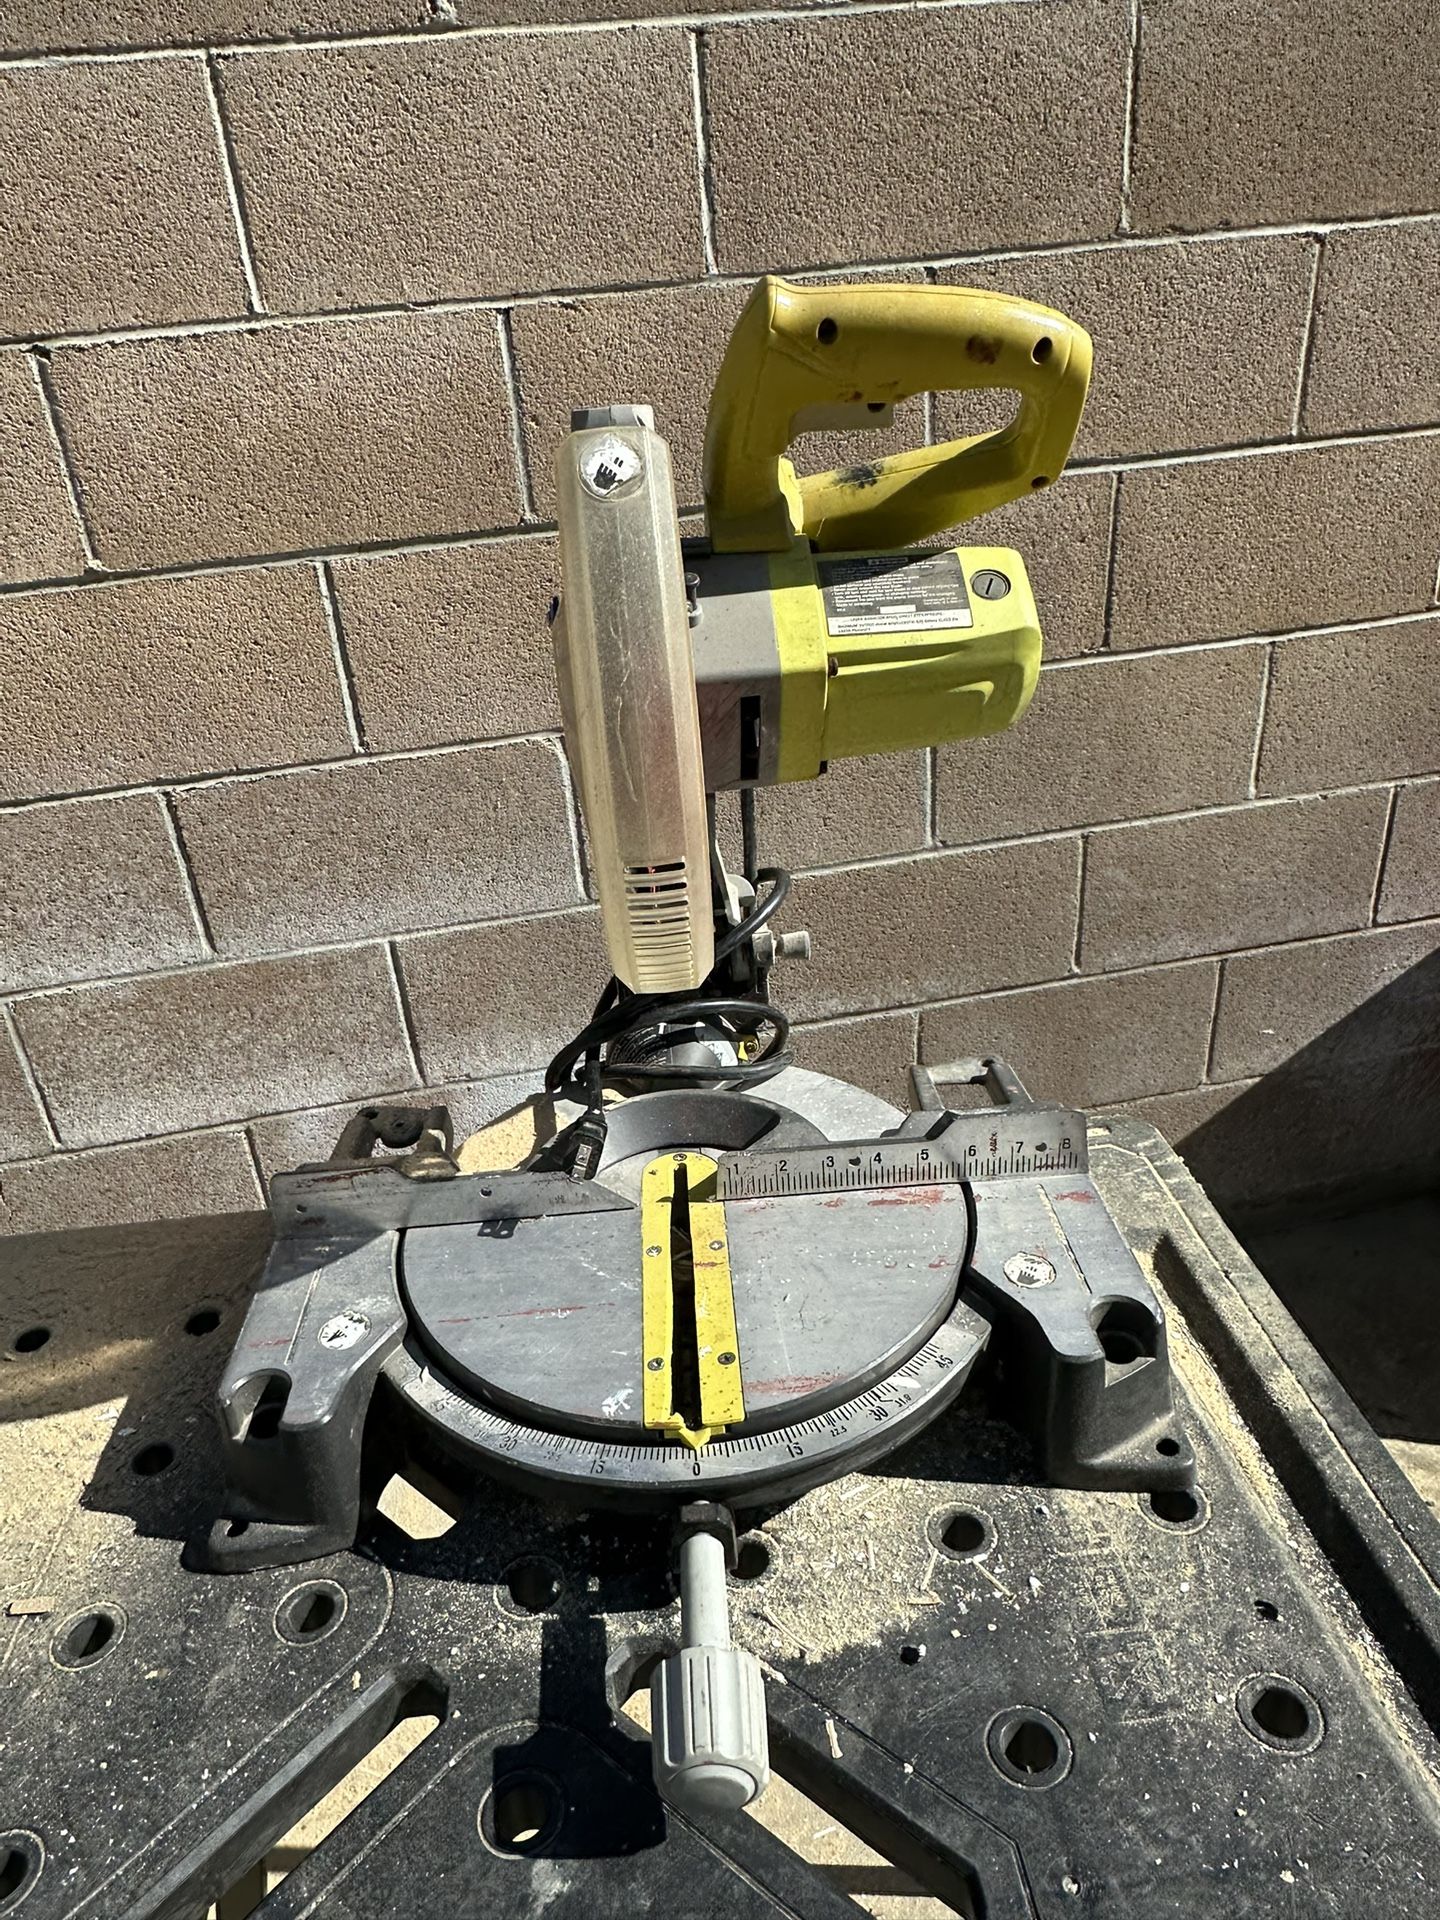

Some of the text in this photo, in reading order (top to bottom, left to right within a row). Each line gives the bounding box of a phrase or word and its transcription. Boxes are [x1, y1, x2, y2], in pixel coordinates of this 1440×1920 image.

[733, 1138, 1071, 1175] 1 2 3 4 5 6 7 8
[499, 1435, 518, 1451] 30
[590, 1459, 605, 1474] 15
[692, 1462, 701, 1476] 0
[787, 1441, 804, 1458] 15
[830, 1425, 847, 1437] 22.5
[868, 1405, 889, 1421] 30
[935, 1354, 954, 1369] 45
